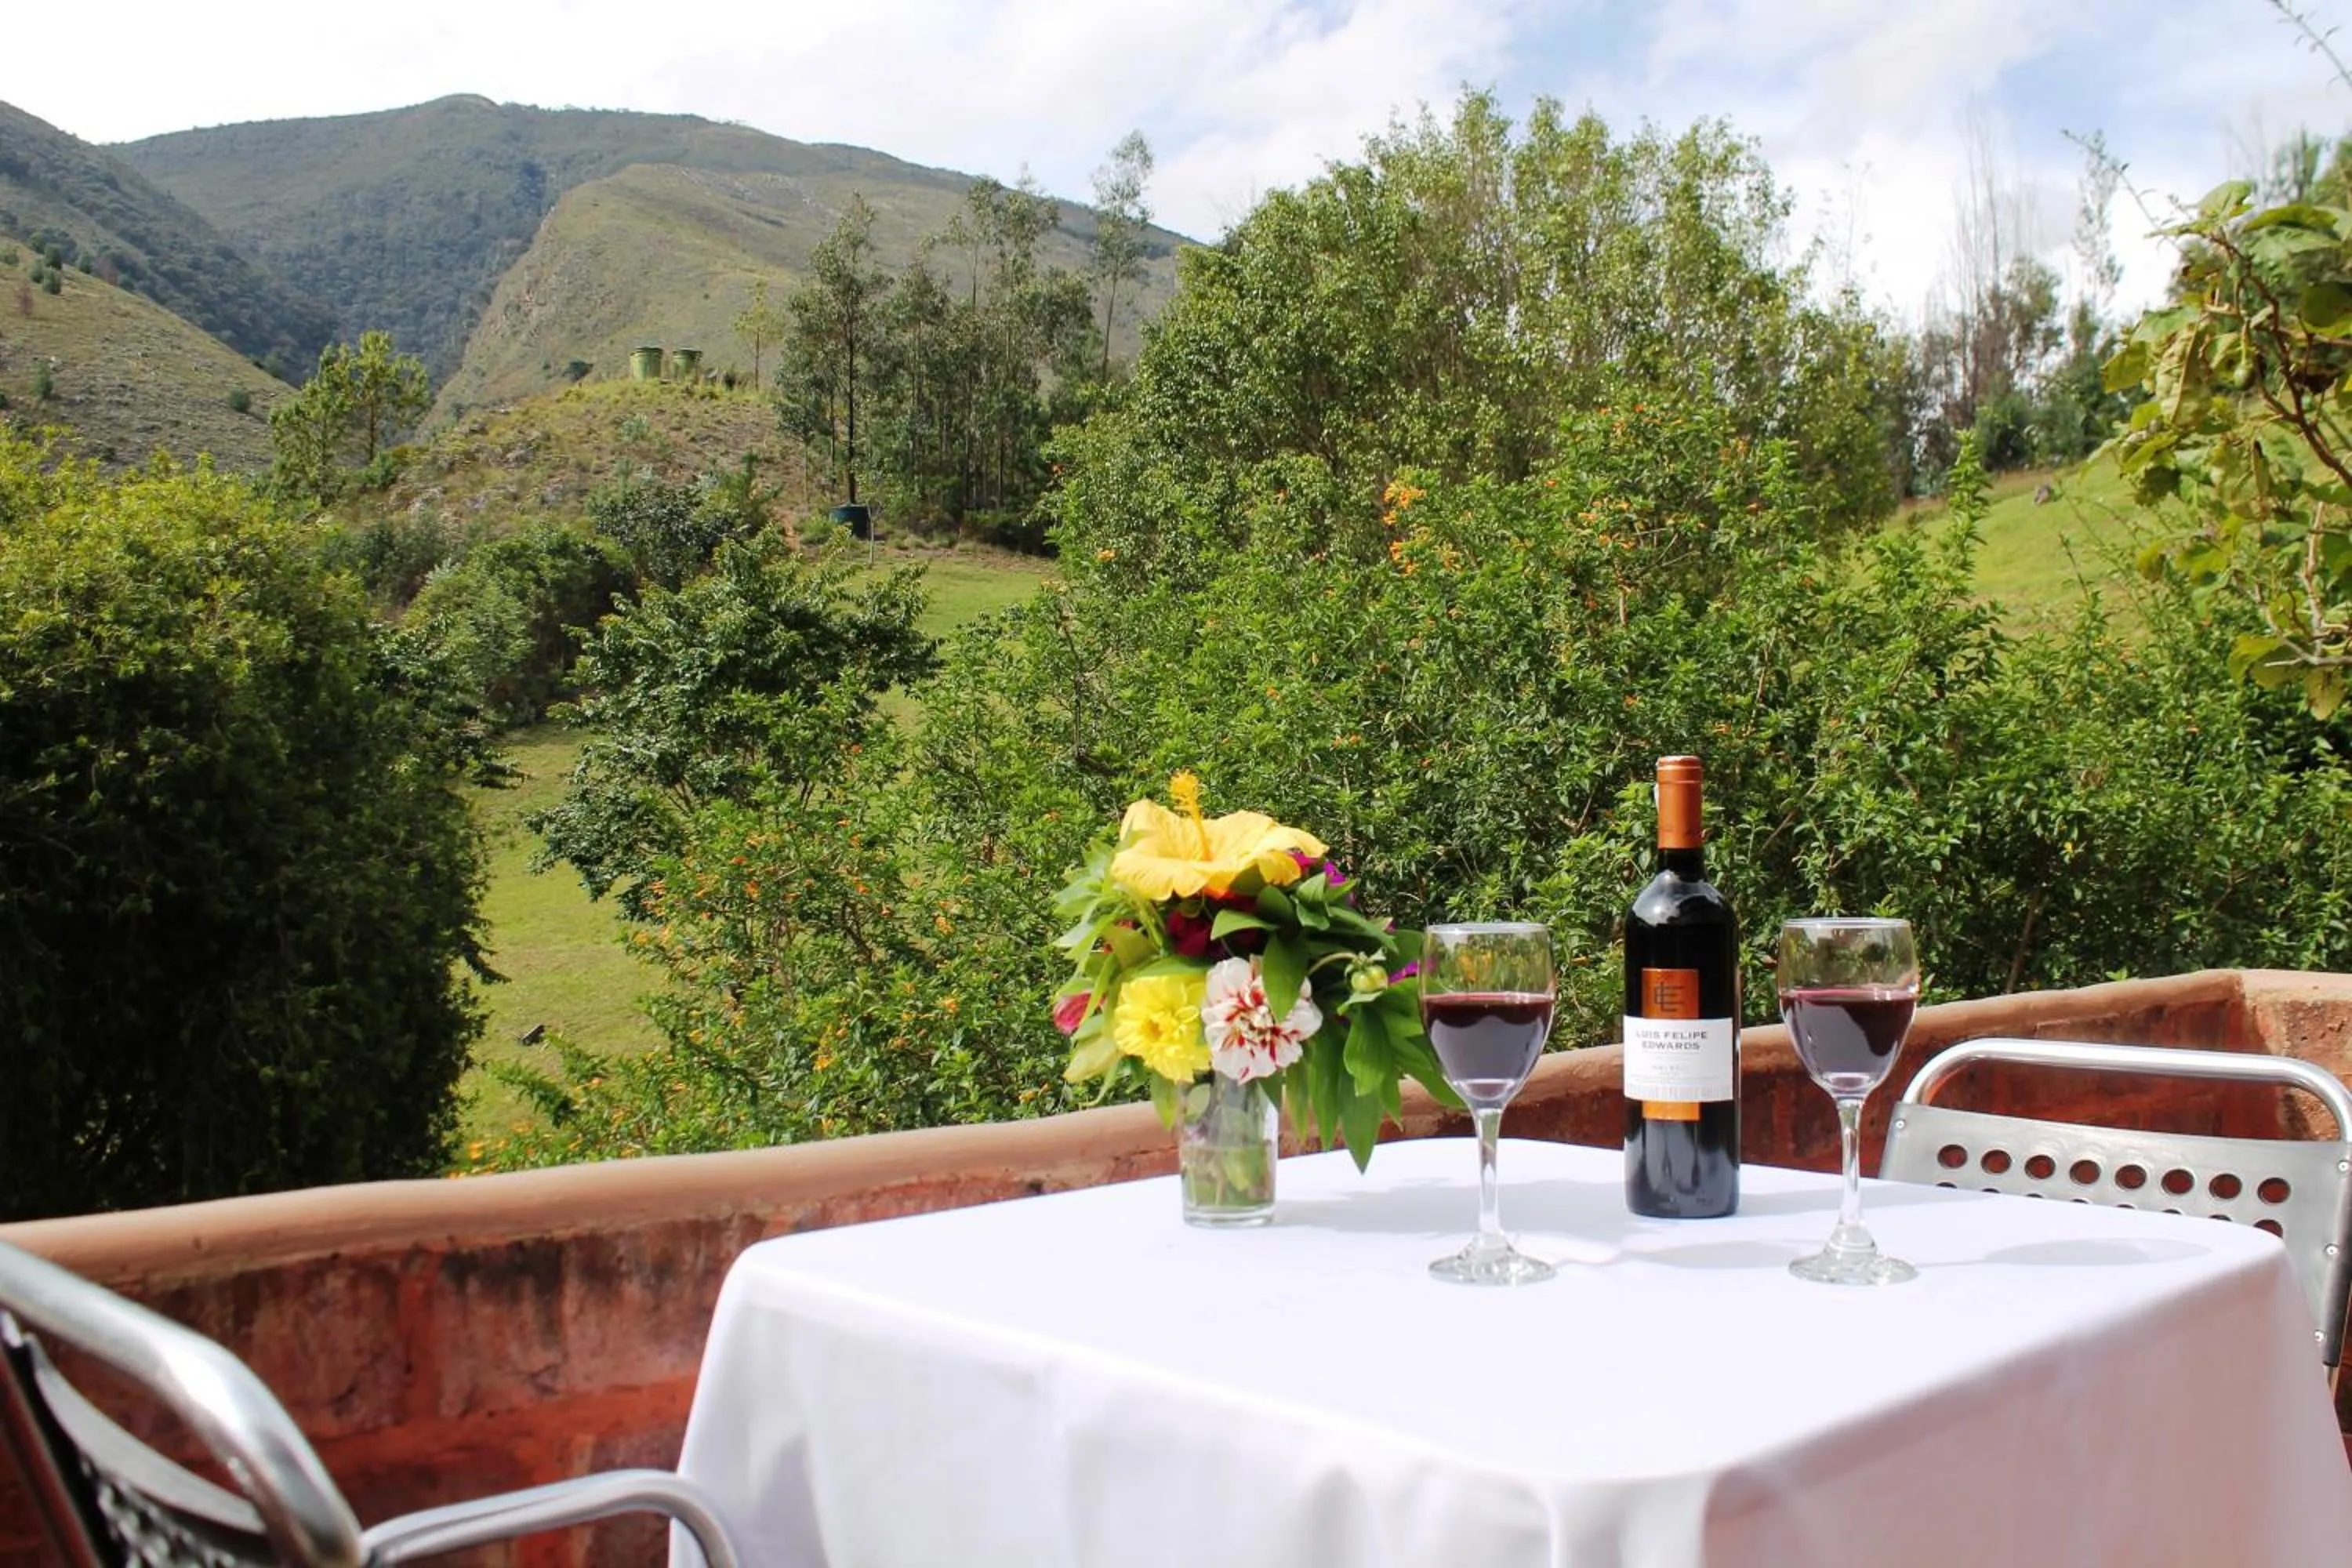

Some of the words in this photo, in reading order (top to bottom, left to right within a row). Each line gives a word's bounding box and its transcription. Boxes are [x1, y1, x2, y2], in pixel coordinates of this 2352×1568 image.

[1635, 1030, 1661, 1039] LUIS
[1663, 1031, 1708, 1040] FELIPE
[1642, 1041, 1700, 1051] EDWARDS
